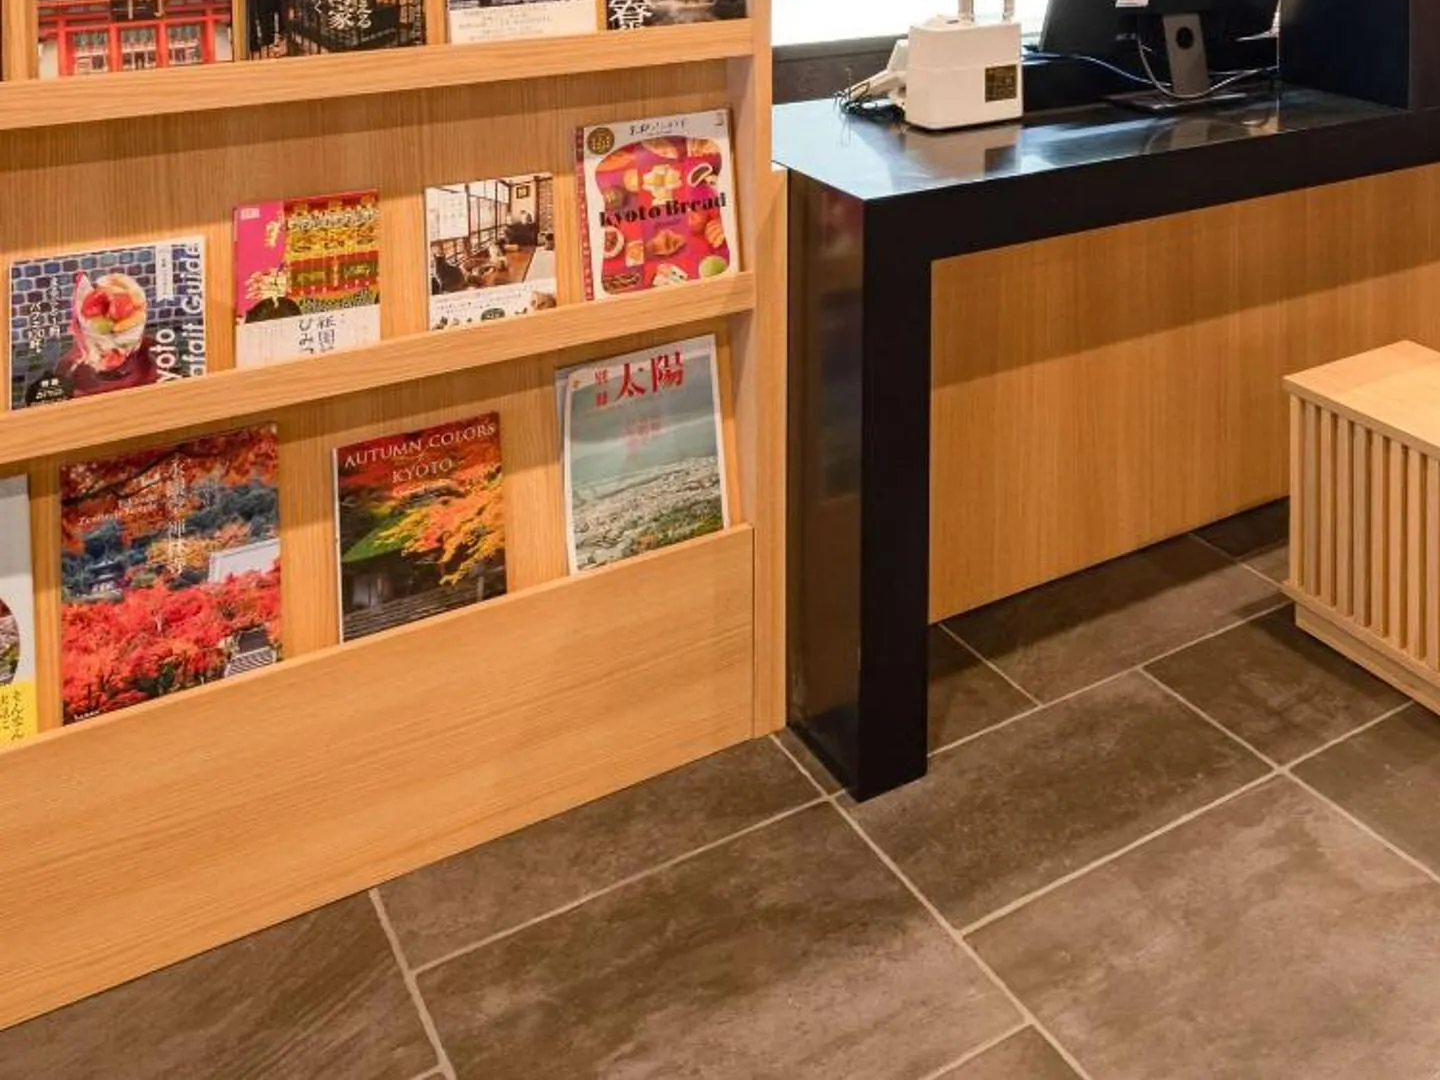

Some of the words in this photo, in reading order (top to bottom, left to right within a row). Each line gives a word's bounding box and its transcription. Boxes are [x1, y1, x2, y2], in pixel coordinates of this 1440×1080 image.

[665, 192, 727, 217] Bread
[179, 243, 204, 313] Guide
[150, 329, 181, 382] yoto
[617, 351, 685, 400] 太陽
[344, 439, 422, 468] AUTUMN
[429, 422, 497, 448] COLORS
[391, 458, 454, 484] KYOTO
